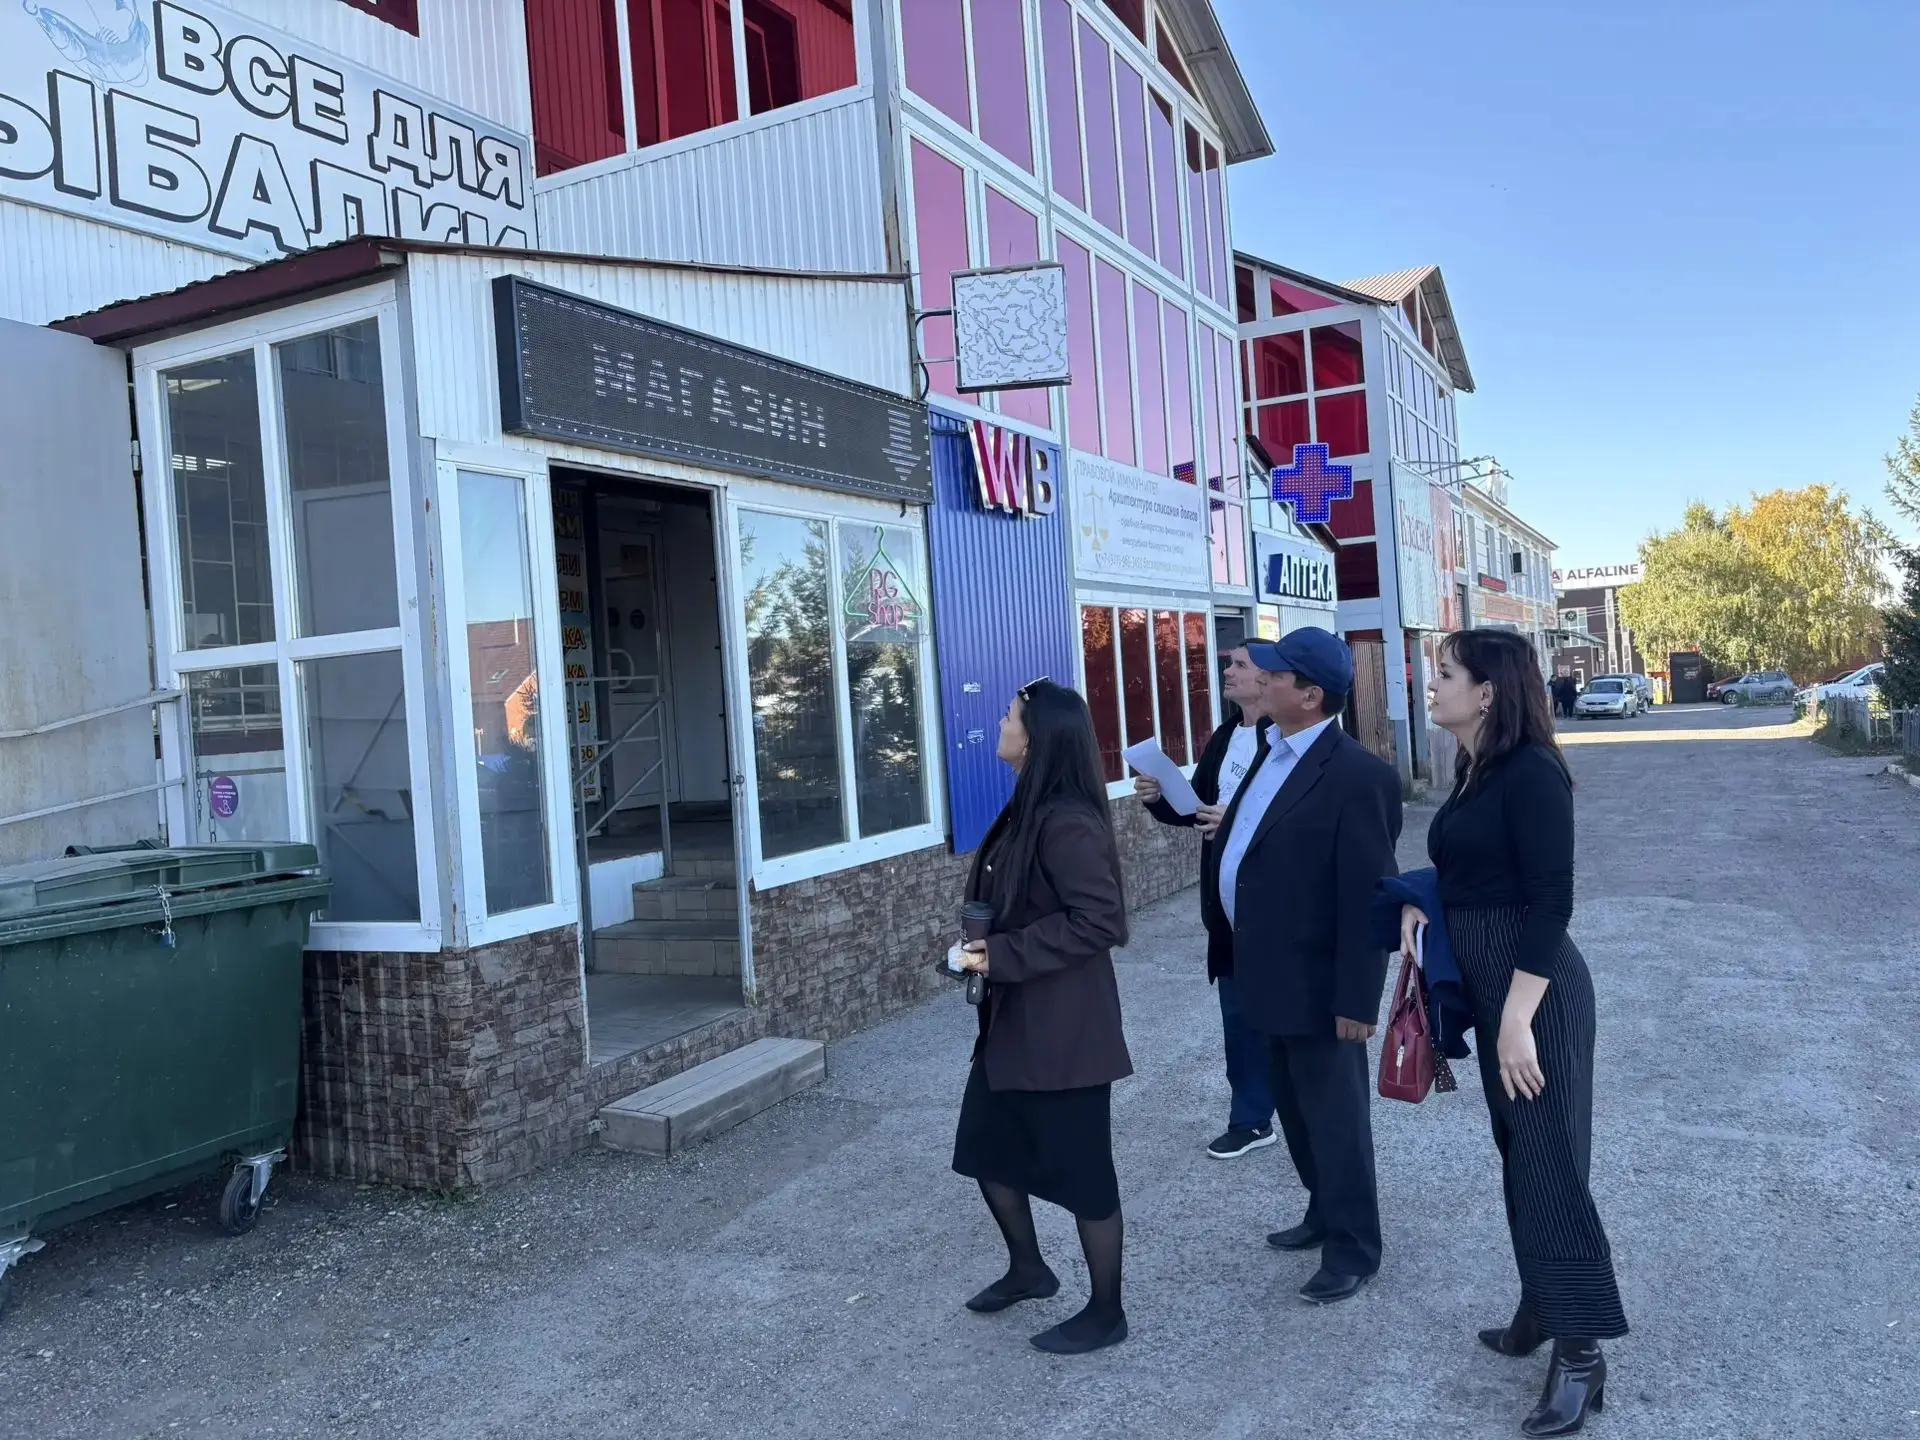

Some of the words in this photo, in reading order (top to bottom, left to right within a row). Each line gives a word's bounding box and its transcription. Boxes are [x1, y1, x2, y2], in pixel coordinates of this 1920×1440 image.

[154, 0, 347, 144] ВСЕ
[369, 89, 524, 209] ДЛЯ
[593, 343, 827, 448] МАГАЗИН
[966, 418, 1058, 518] WB
[1108, 487, 1153, 514] Архитектура
[1153, 501, 1179, 517] списания
[1180, 505, 1198, 522] долгов
[869, 567, 898, 599] RG
[1279, 552, 1333, 601] АПТЕКА
[1566, 563, 1639, 581] ALFALINE
[867, 588, 905, 632] shop
